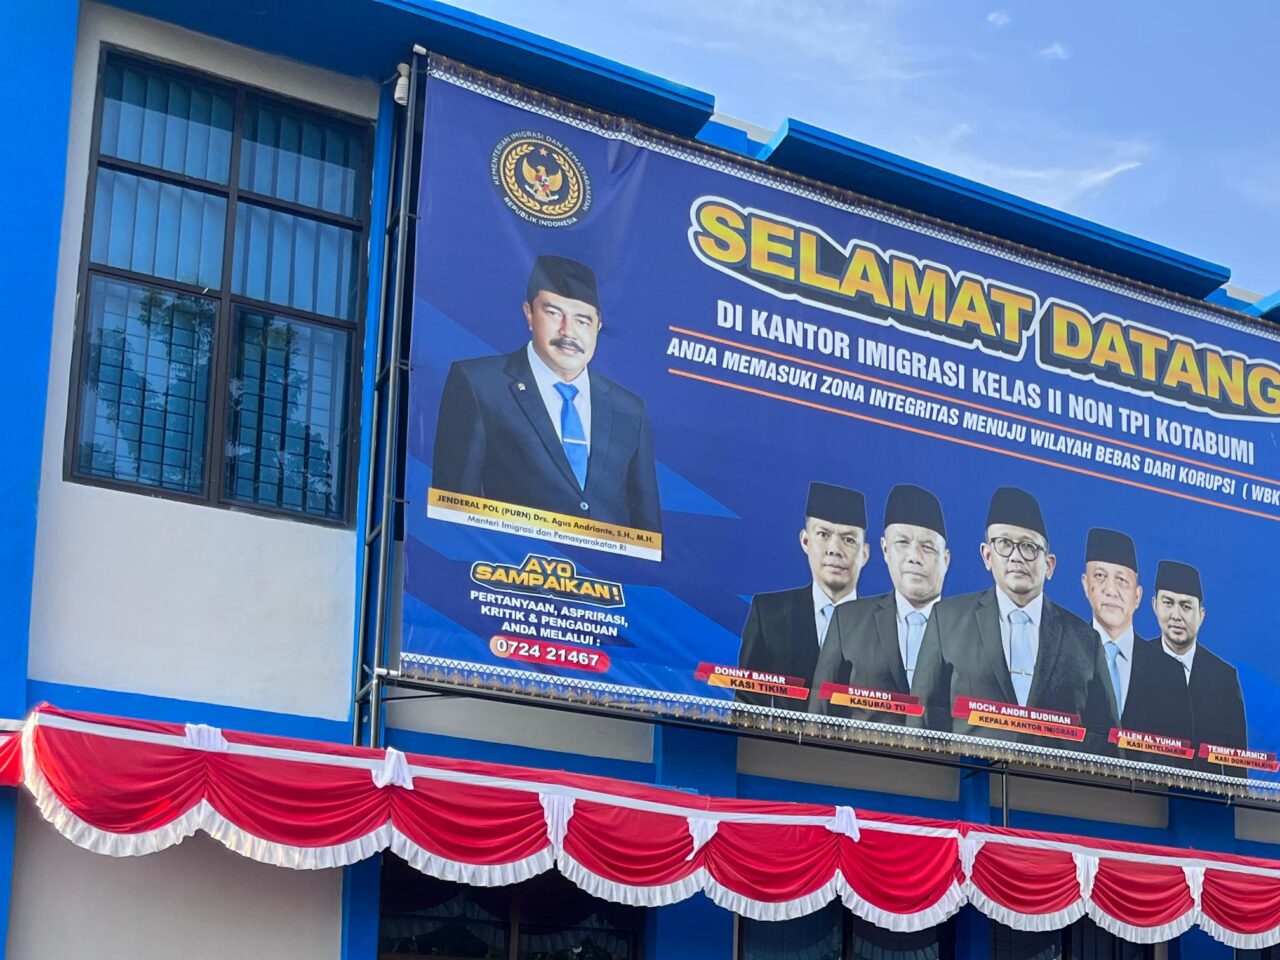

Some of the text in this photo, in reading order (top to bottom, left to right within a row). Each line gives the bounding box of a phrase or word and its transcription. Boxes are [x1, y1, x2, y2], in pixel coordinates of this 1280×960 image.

[511, 131, 544, 139] IMIGRASI
[546, 136, 563, 148] DAN
[503, 197, 578, 227] REPUBLIK INDONESIA
[697, 203, 1034, 344] SELAMAT
[717, 299, 1254, 465] DI KANTOR IMIGRASI KELAS II NON TPI KOTABUMI
[667, 337, 717, 367] ANDA
[722, 350, 817, 391] MEMASUKI
[820, 375, 865, 402] ZONA
[869, 388, 959, 426] INTEGRITAS
[962, 412, 1027, 443] MENUJU
[1030, 428, 1093, 460] WILAYAH
[1095, 447, 1141, 472] BEBAS
[1144, 458, 1175, 481] DARI
[1178, 466, 1235, 496] KORUPSI
[1251, 486, 1280, 507] WBK
[437, 495, 480, 509] JENDERAL
[483, 504, 499, 513] POL
[501, 508, 531, 521] (PURN)
[533, 514, 549, 523] Drs.
[551, 518, 571, 528] Agus
[636, 534, 654, 544] M.H.
[467, 515, 627, 552] Menteri Imigrasi dan Pemasyarakatan RI
[525, 558, 572, 578] AYO
[470, 590, 629, 628] PERTANYAAN, ASPRIRASI,
[481, 605, 618, 637] KRITIK & PENGADUAN
[501, 621, 537, 636] ANDA
[540, 627, 593, 646] MELALUI
[496, 639, 600, 666] 0724 21467
[714, 666, 786, 685] DONNY BAHAR
[730, 678, 788, 695] KASI TIKIM
[847, 687, 892, 701] SUWARDI
[849, 697, 907, 712] KASUBAG TU
[968, 701, 1071, 725] MOCH. ANDRI BUDIMAN
[978, 716, 1078, 737] KEPALA KANTOR IMIGRASI
[1117, 730, 1142, 741] ALLEN
[1144, 735, 1153, 743] AL
[1126, 740, 1143, 748] KASI
[1208, 745, 1268, 760] TEMMY TARMIZI
[1215, 755, 1230, 763] KASI
